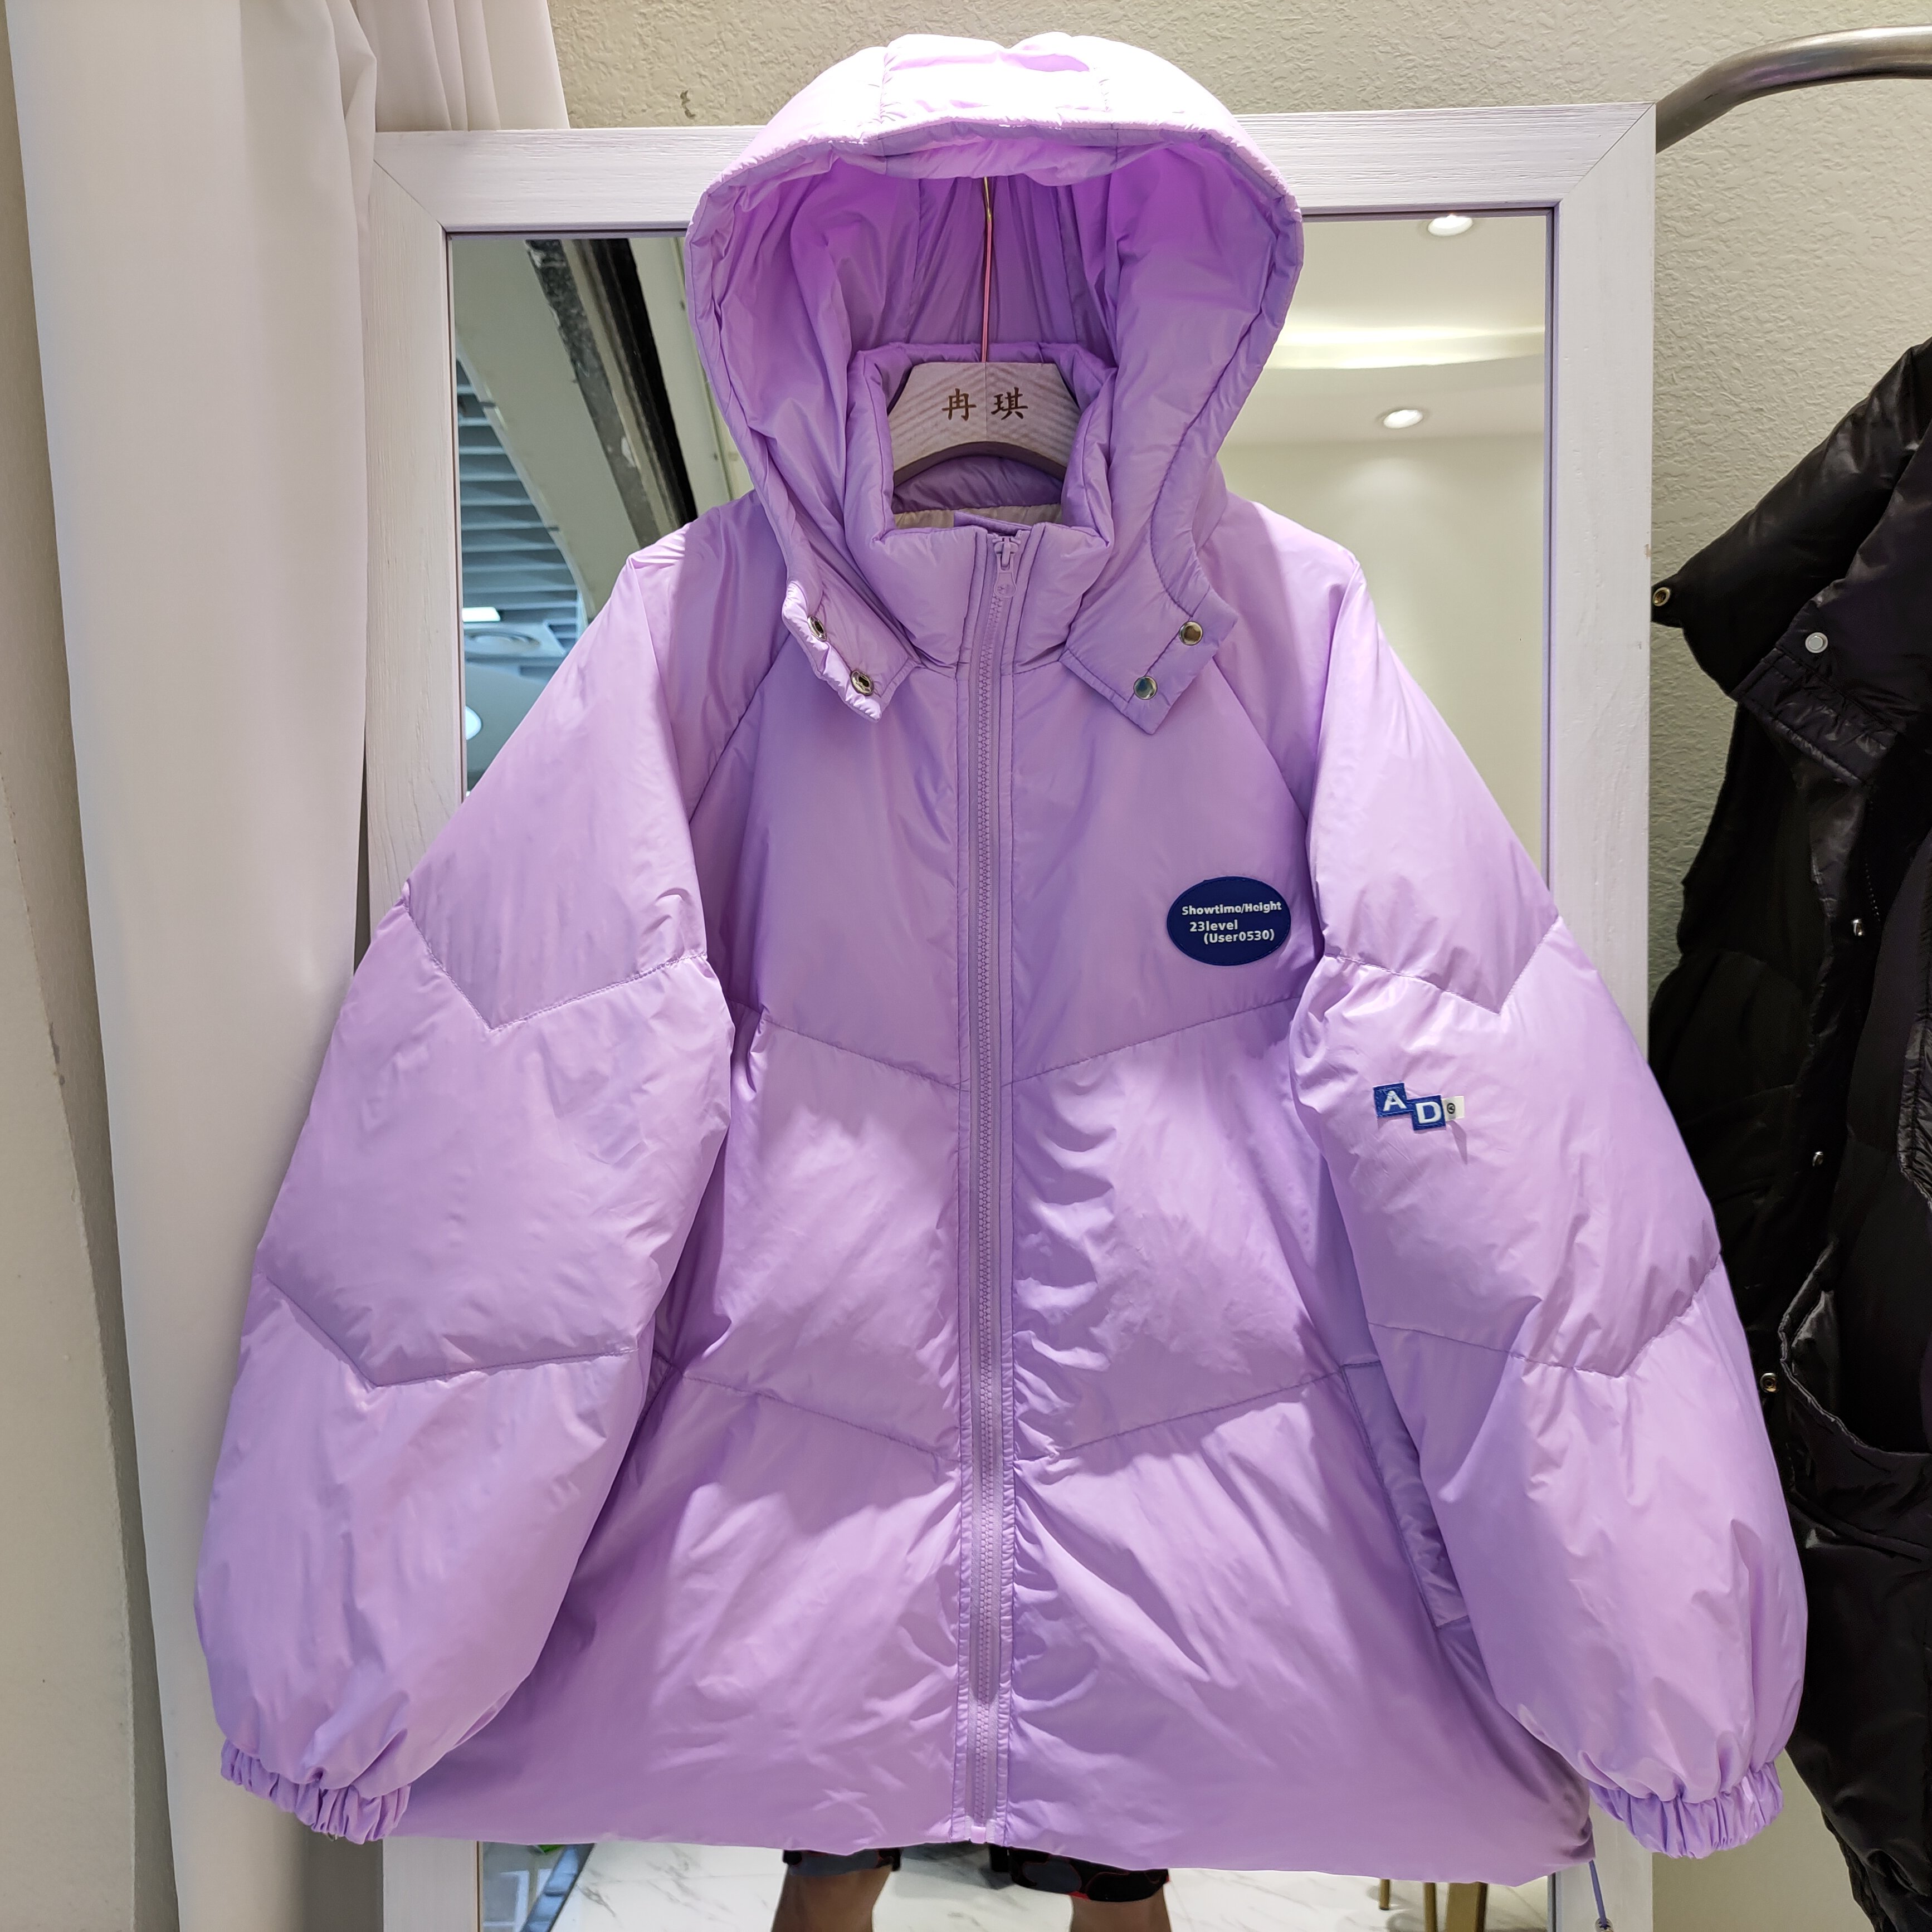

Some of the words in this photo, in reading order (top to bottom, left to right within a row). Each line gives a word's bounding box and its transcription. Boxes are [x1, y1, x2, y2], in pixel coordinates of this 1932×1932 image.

[941, 387, 1028, 421] 冉琪
[1189, 919, 1238, 932] 23level
[1204, 929, 1275, 945] (User0530)
